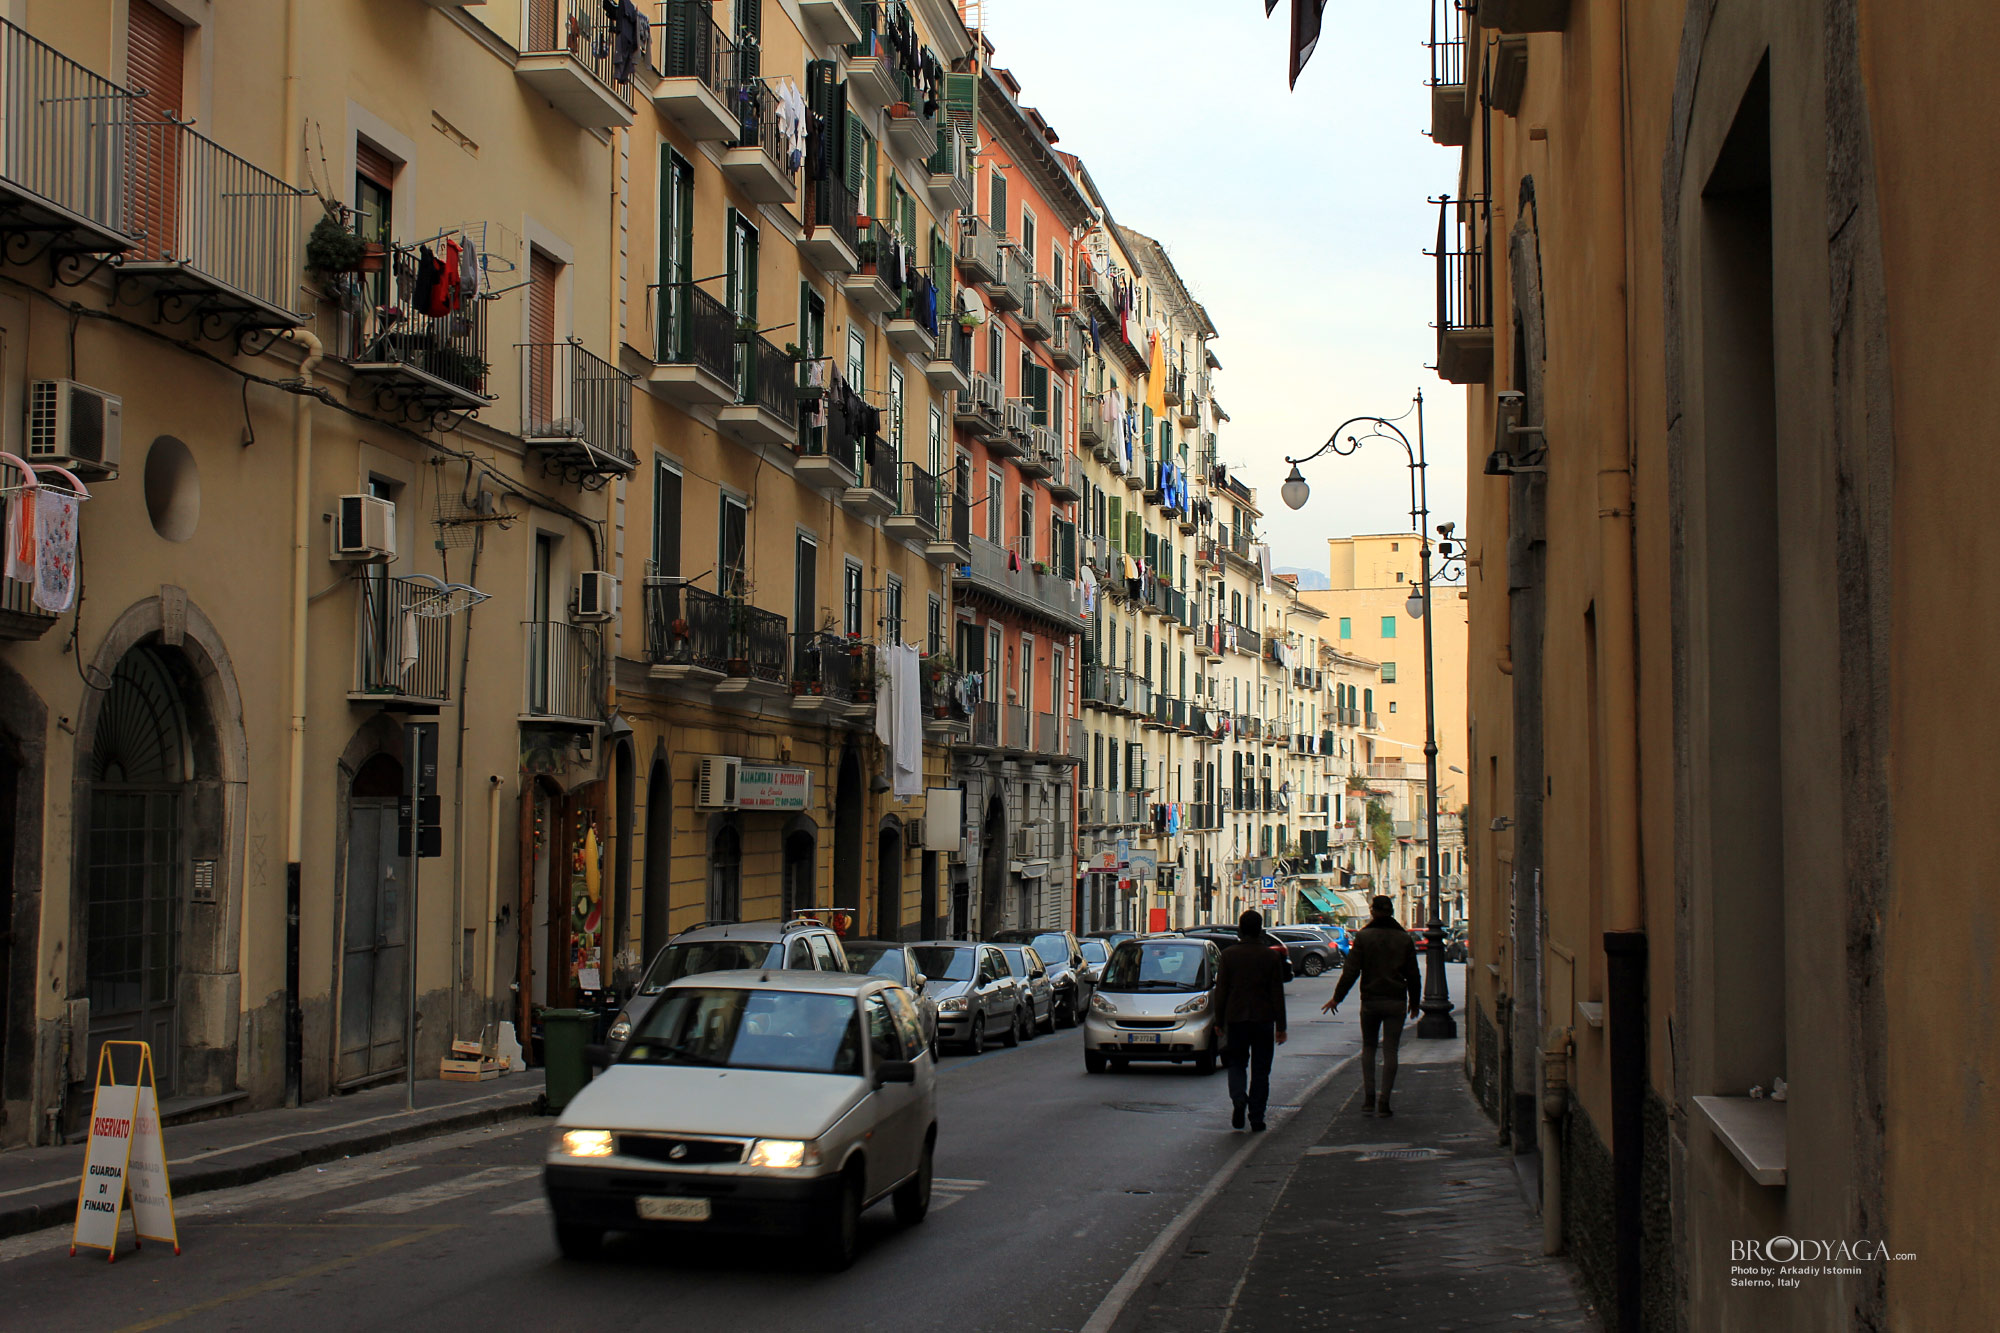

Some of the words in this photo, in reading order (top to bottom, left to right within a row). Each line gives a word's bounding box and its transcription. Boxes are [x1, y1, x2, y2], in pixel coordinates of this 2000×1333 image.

[1265, 878, 1271, 886] P
[93, 1117, 130, 1139] RISERVATO
[90, 1165, 122, 1178] GUARDIA
[99, 1184, 107, 1194] DI
[84, 1201, 115, 1213] FINANZA
